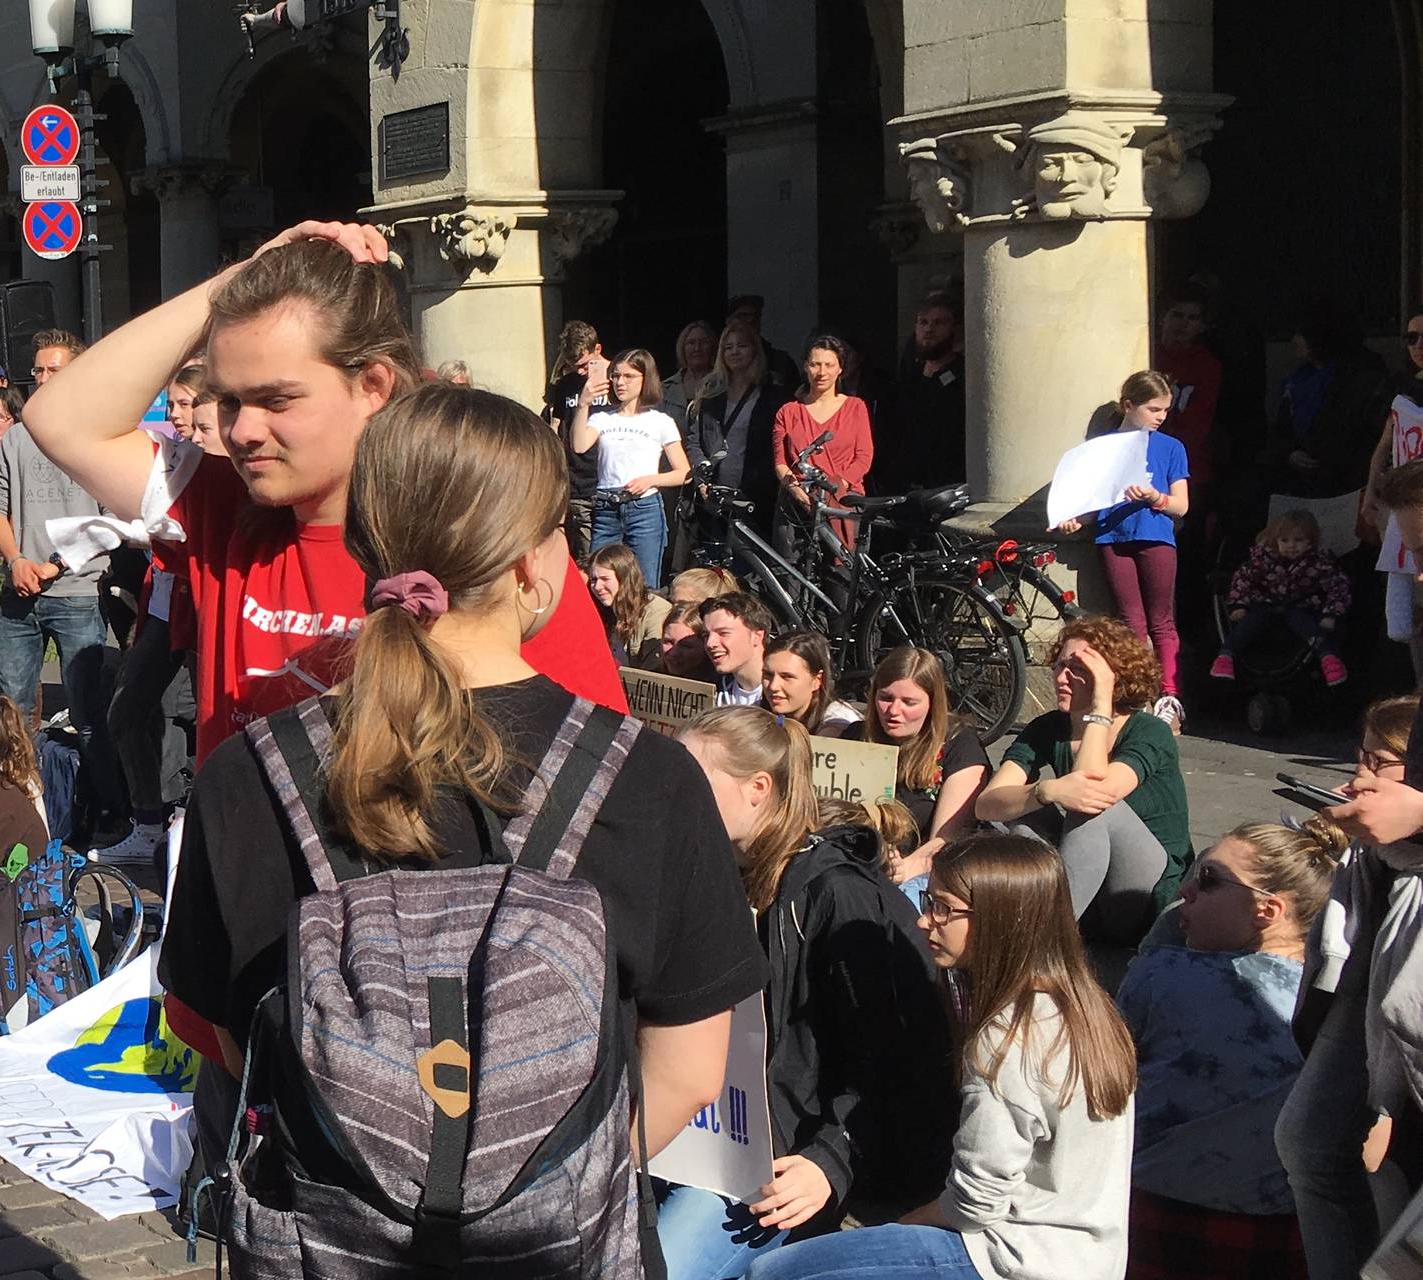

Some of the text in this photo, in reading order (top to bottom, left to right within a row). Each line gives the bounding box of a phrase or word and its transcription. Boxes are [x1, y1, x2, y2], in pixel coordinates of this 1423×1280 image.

[25, 171, 76, 182] Be-/Entladen
[37, 187, 65, 196] erlaubt
[623, 677, 709, 719] WENN NICHT
[1, 944, 19, 992] Satch
